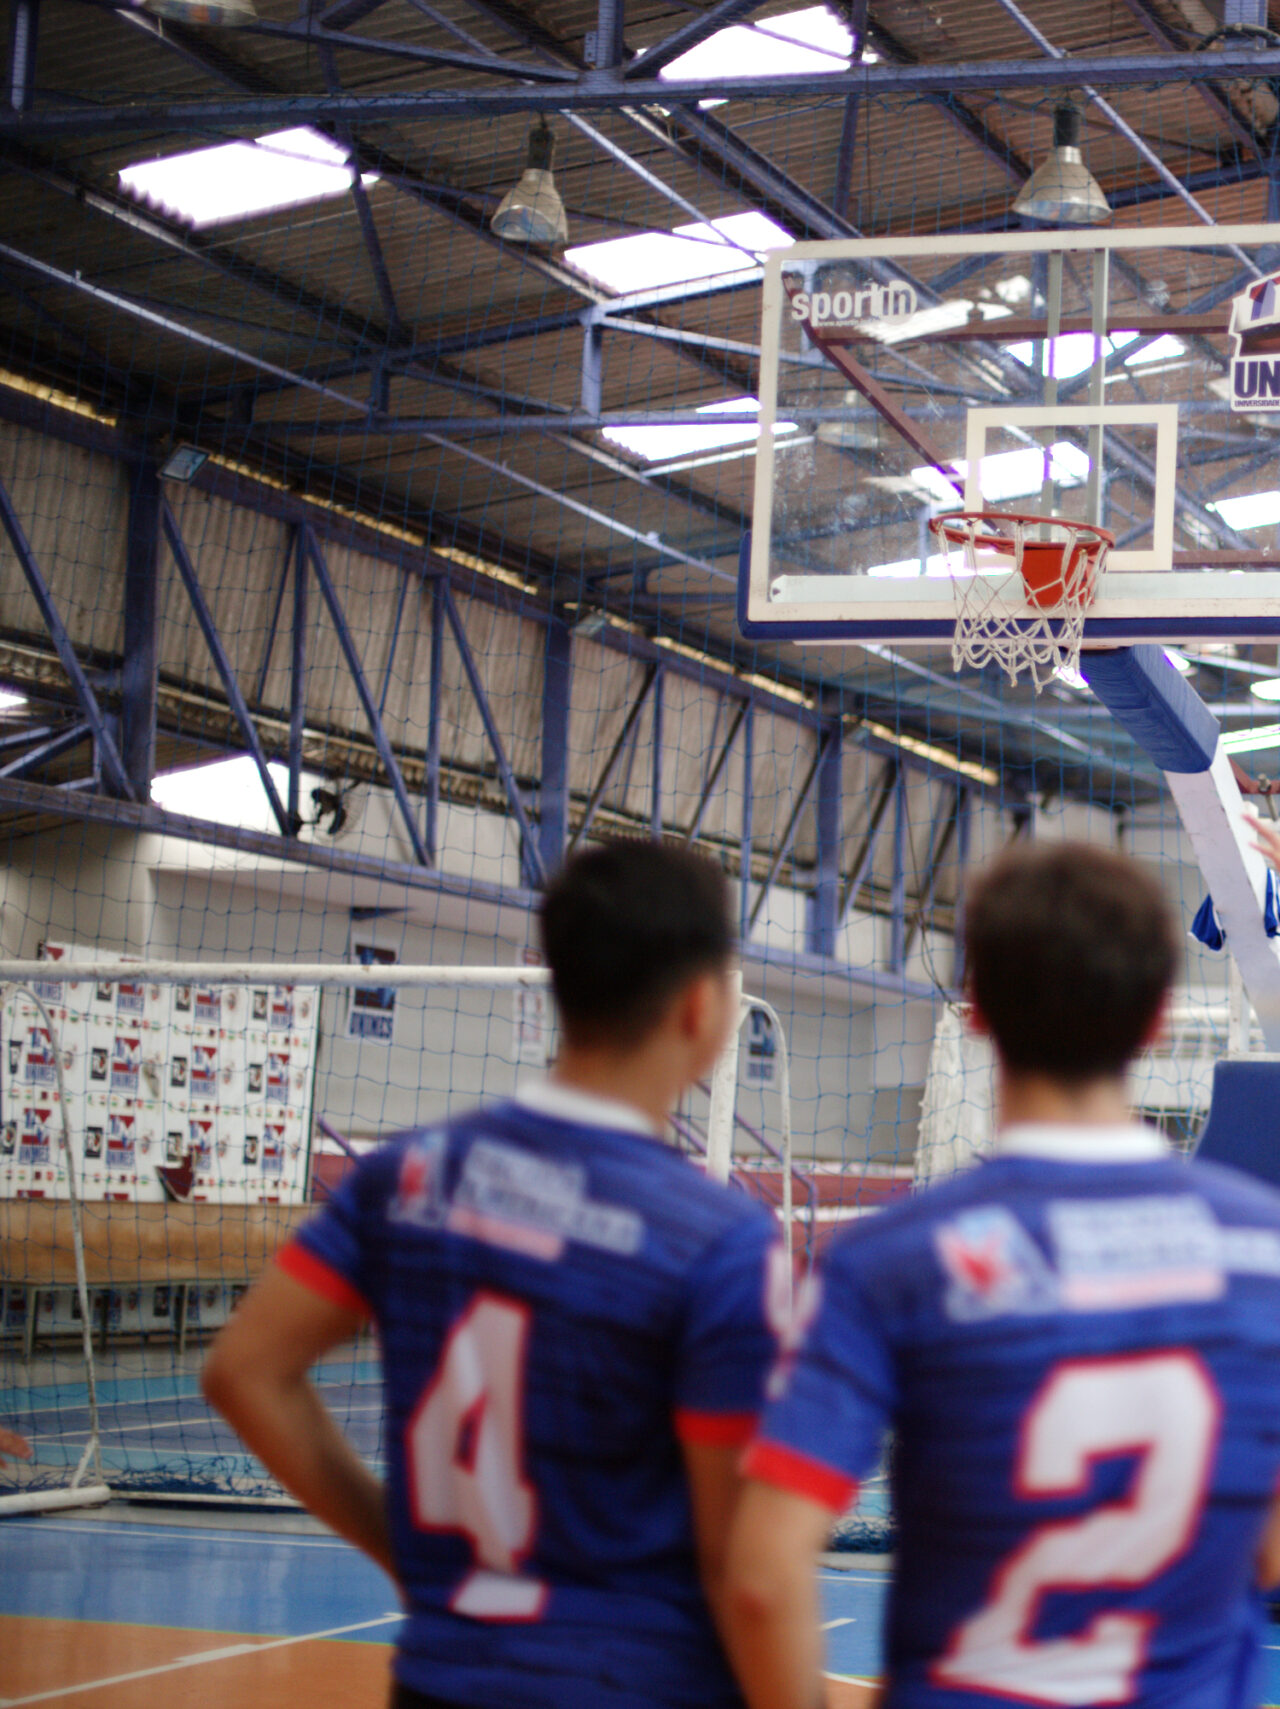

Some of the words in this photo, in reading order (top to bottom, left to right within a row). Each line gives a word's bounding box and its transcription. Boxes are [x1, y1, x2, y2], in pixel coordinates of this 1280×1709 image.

[1234, 399, 1280, 407] UNIVERSIDADE
[404, 1289, 547, 1623] 4
[929, 1347, 1221, 1707] 2
